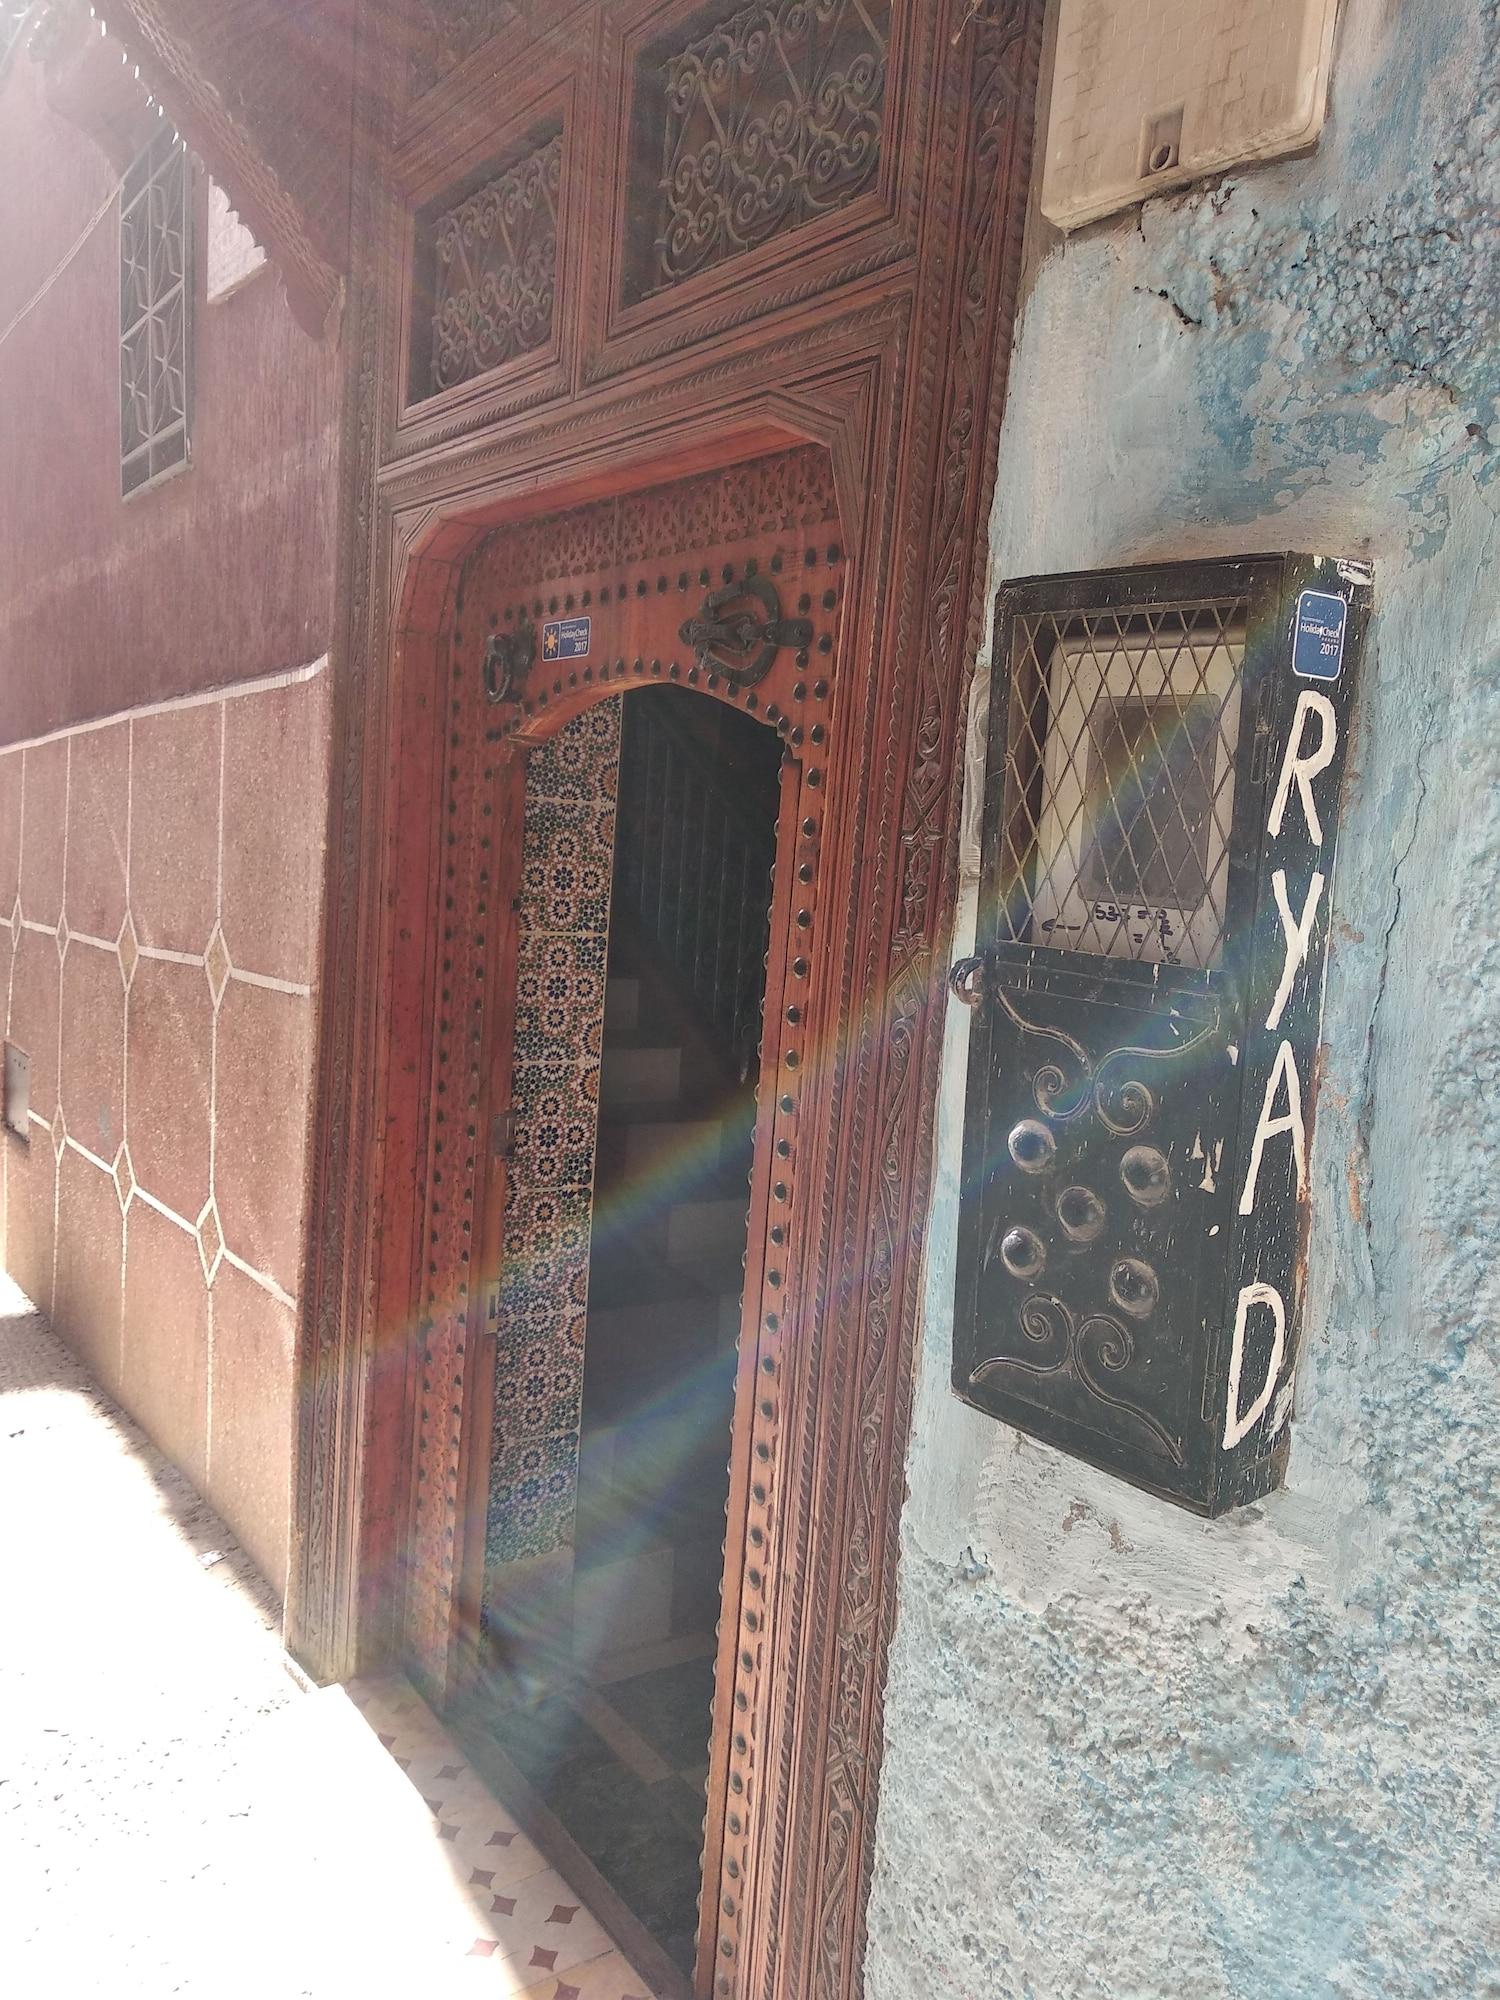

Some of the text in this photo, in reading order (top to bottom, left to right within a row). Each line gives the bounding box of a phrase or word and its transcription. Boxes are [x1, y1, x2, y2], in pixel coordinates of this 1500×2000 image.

[1300, 623, 1340, 638] HolidayCheck
[574, 641, 587, 652] 2017
[1320, 643, 1339, 656] 2017
[1222, 690, 1336, 1450] RYAD
